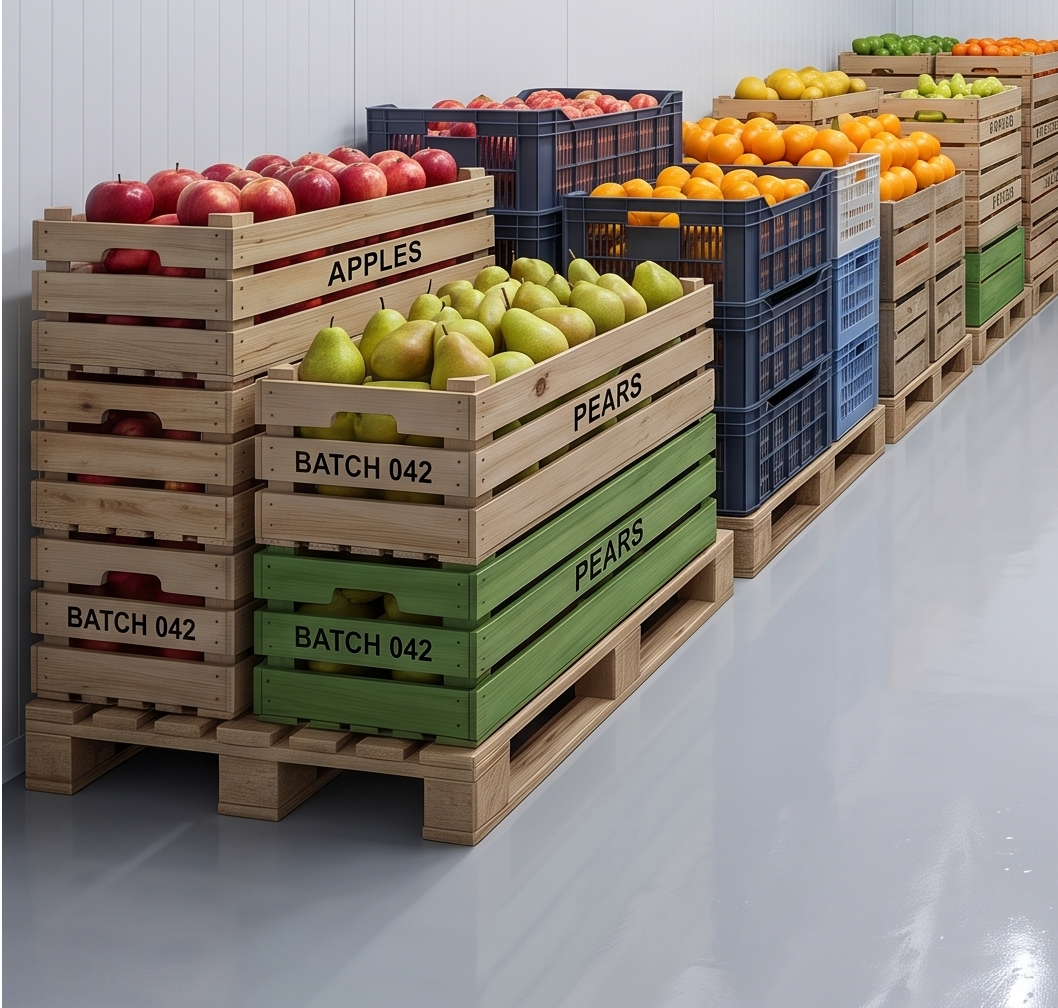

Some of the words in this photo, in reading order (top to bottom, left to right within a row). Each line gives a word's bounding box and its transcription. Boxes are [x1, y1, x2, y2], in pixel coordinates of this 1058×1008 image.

[327, 240, 422, 287] APPLES
[574, 372, 643, 432] PEARS
[294, 450, 381, 480] BATCH
[388, 457, 433, 484] 042
[575, 517, 645, 593] PEARS
[66, 605, 148, 636] BATCH
[154, 615, 197, 642] 042
[294, 625, 381, 657] BATCH
[389, 635, 433, 663] 042
